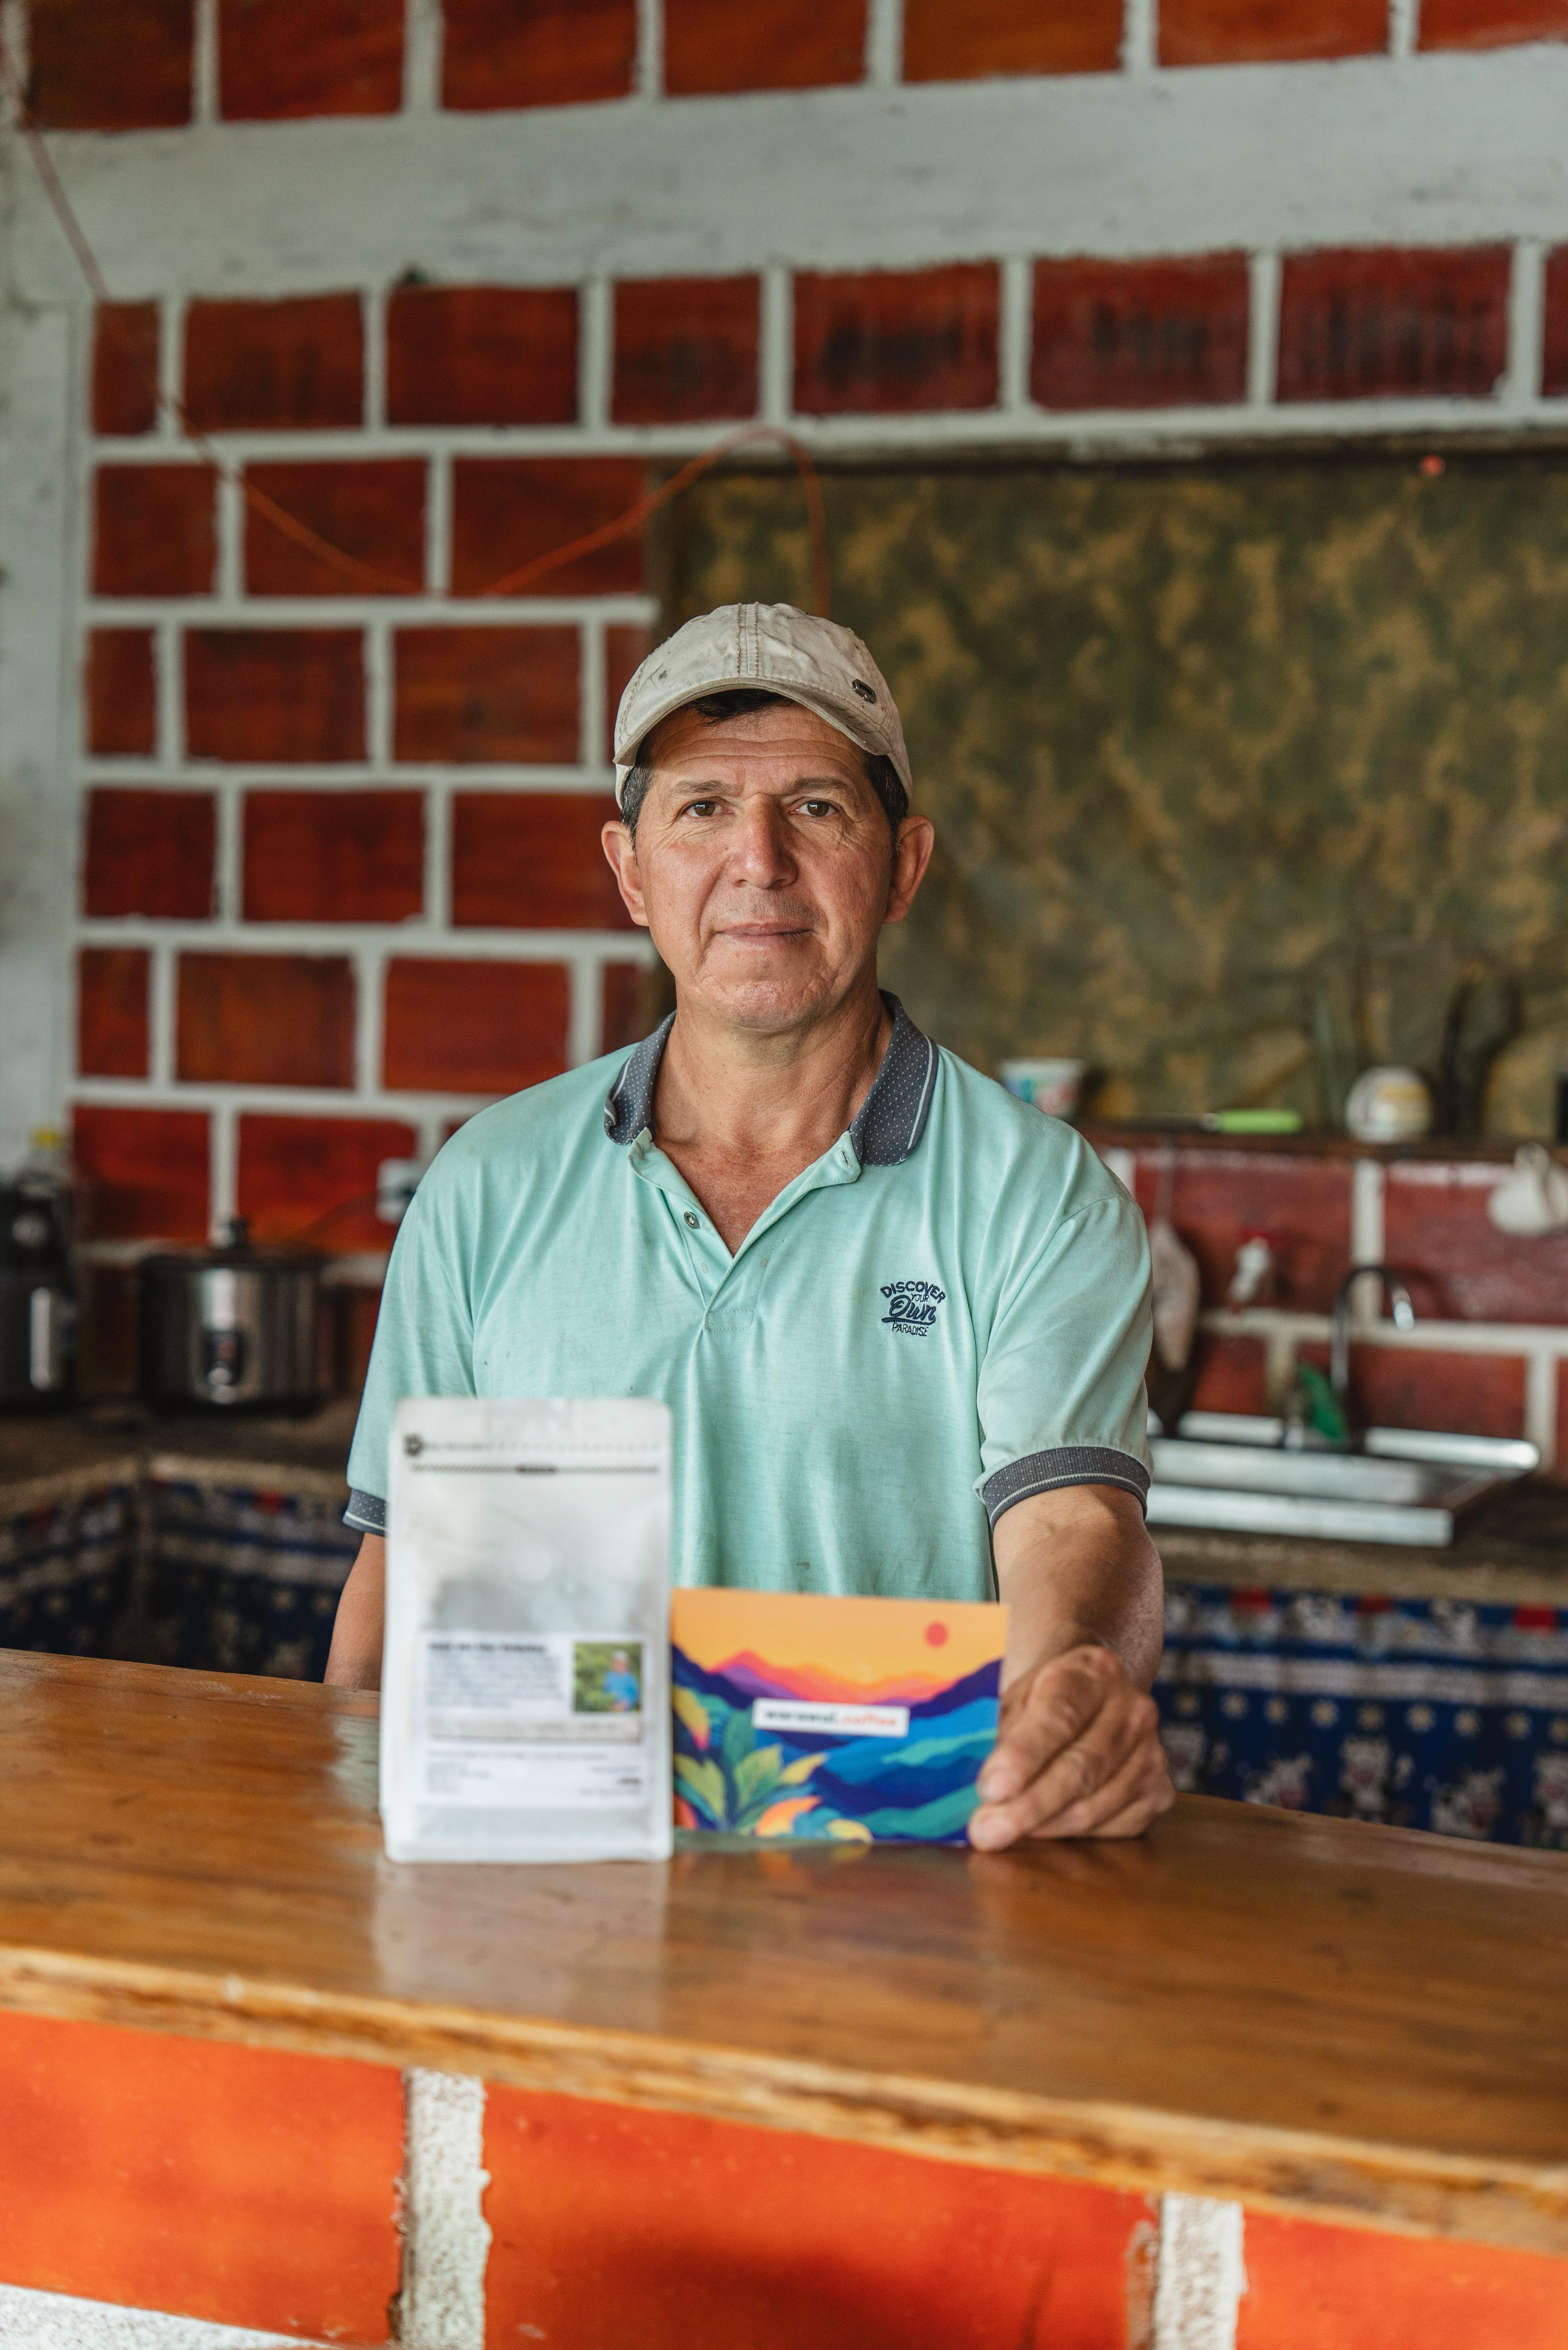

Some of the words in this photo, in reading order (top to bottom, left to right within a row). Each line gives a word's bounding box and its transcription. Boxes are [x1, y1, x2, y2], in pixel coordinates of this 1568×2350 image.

[880, 1281, 946, 1304] DISCOVER
[911, 1293, 930, 1302] YOUR
[892, 1322, 929, 1337] PARADISE
